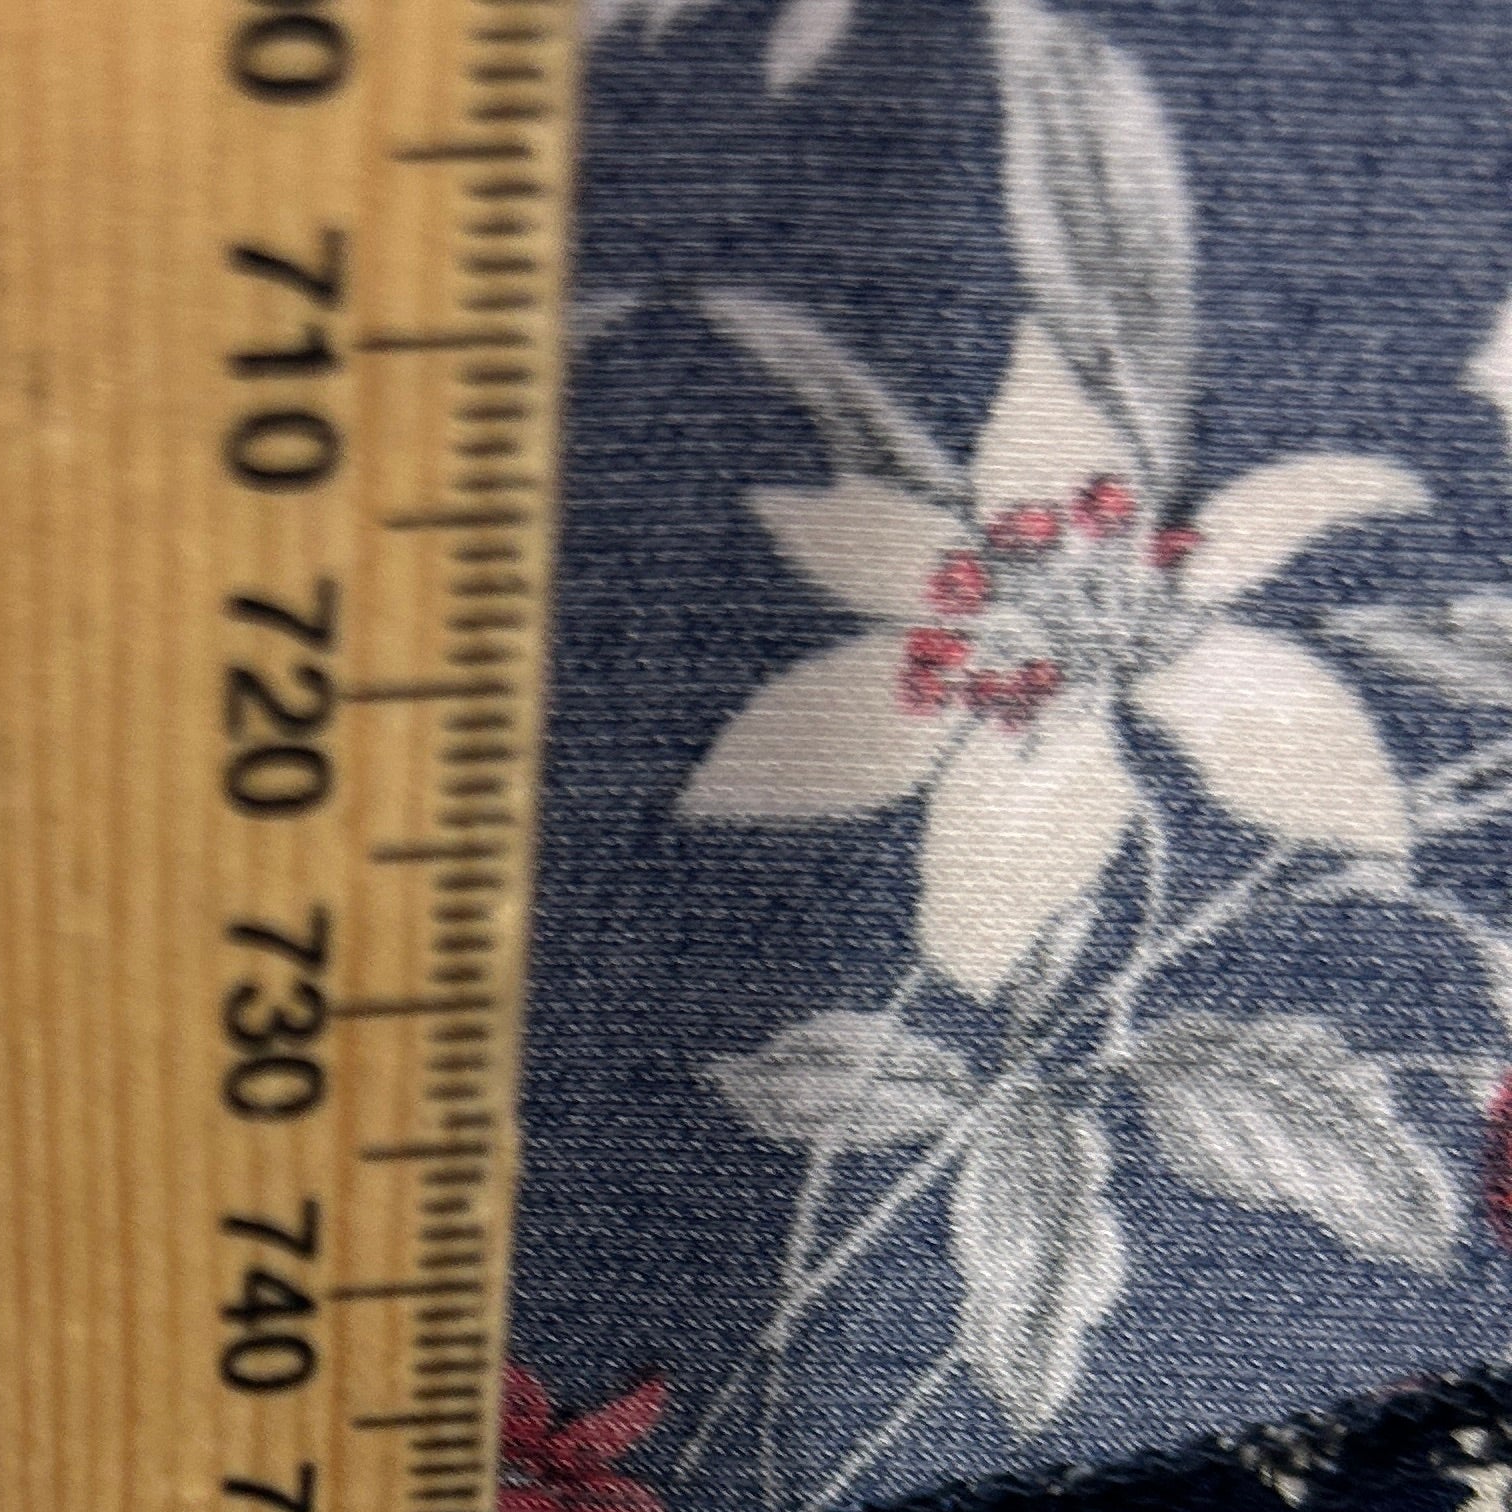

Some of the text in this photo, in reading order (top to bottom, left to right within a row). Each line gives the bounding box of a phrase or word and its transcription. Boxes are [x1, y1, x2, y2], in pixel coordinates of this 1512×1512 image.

[223, 226, 348, 494] 710
[220, 573, 339, 820] 720
[218, 902, 332, 1123] 730
[216, 1195, 322, 1398] 740
